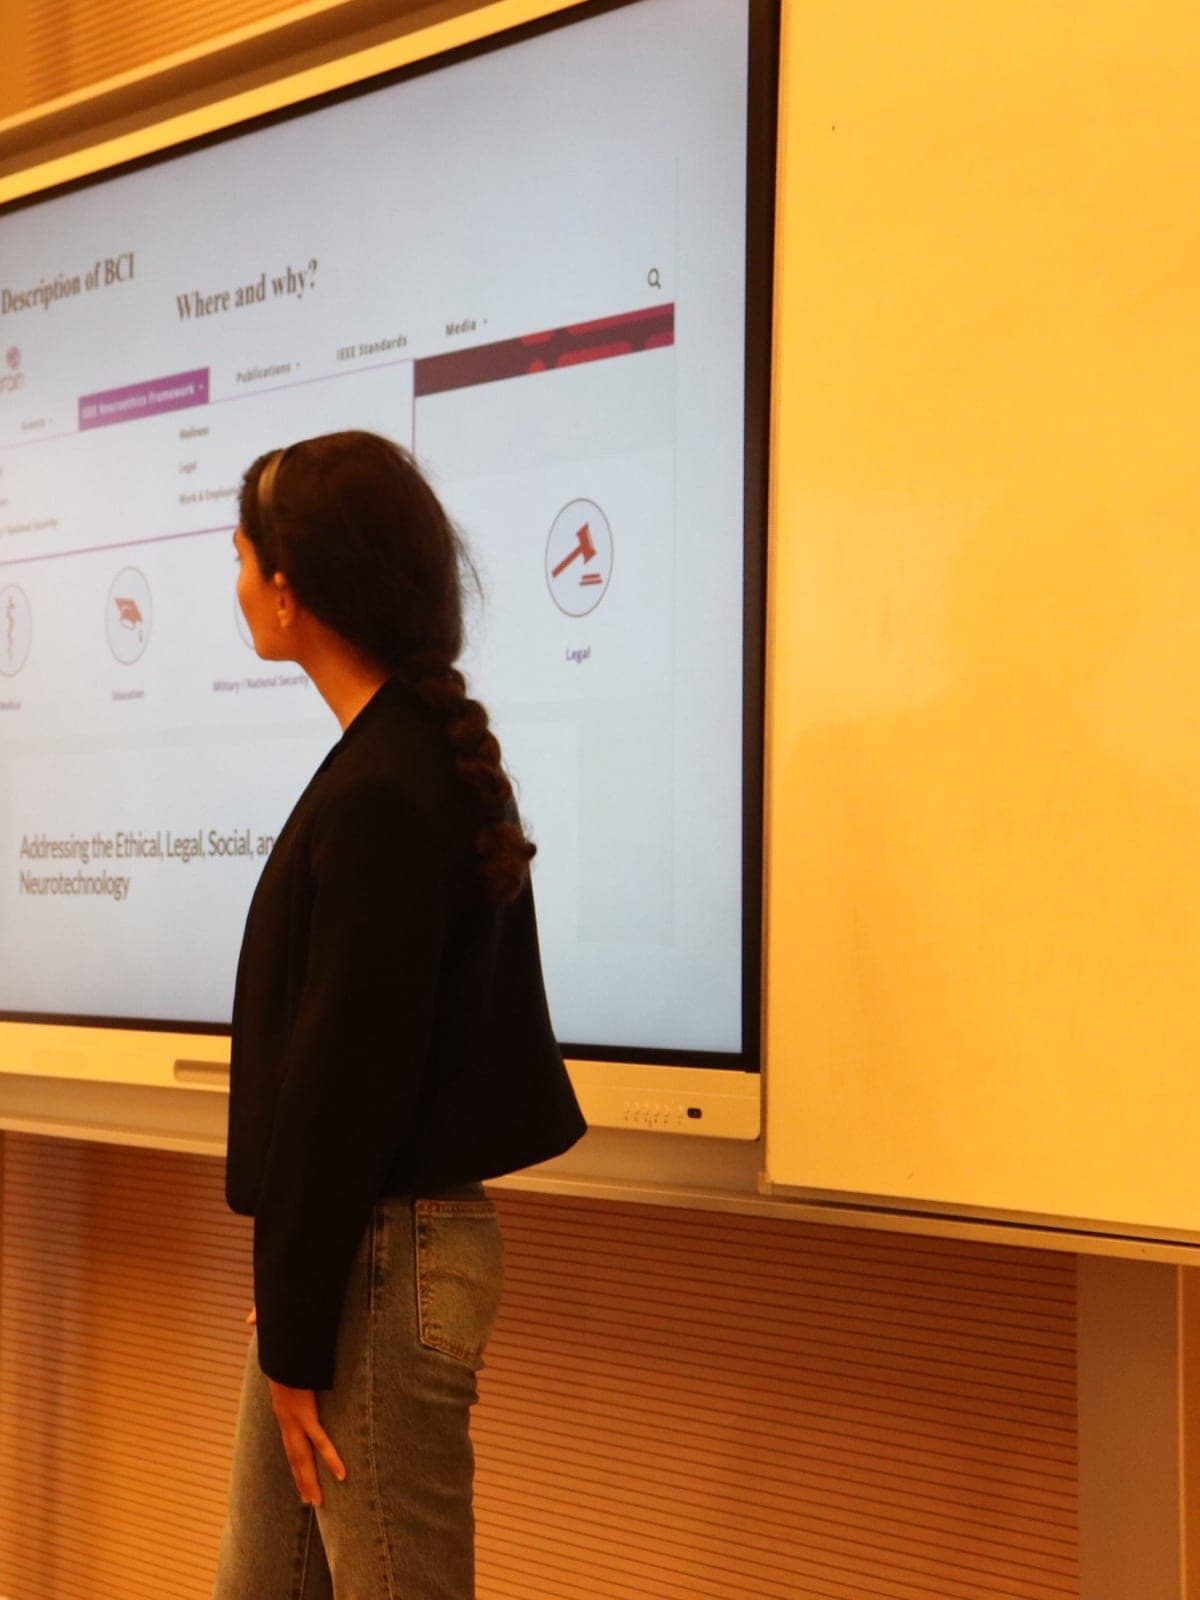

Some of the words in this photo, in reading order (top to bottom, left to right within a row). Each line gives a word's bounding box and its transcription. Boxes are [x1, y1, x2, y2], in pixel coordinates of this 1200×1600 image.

[2, 272, 82, 311] Description
[85, 262, 102, 291] of
[104, 252, 136, 286] BCI
[176, 289, 231, 322] Where
[234, 272, 267, 308] and
[272, 258, 319, 299] why?
[445, 319, 477, 336] Media
[337, 347, 356, 361] IEEE
[359, 334, 408, 357] Standards
[236, 362, 292, 384] Publications
[566, 646, 591, 663] Legal
[20, 834, 90, 864] Addressing
[92, 834, 113, 858] the
[116, 832, 164, 860] Ethical,
[167, 831, 206, 863] Legal,
[208, 829, 254, 860] Social,
[257, 835, 275, 855] an
[20, 870, 130, 901] Neurotechnology
